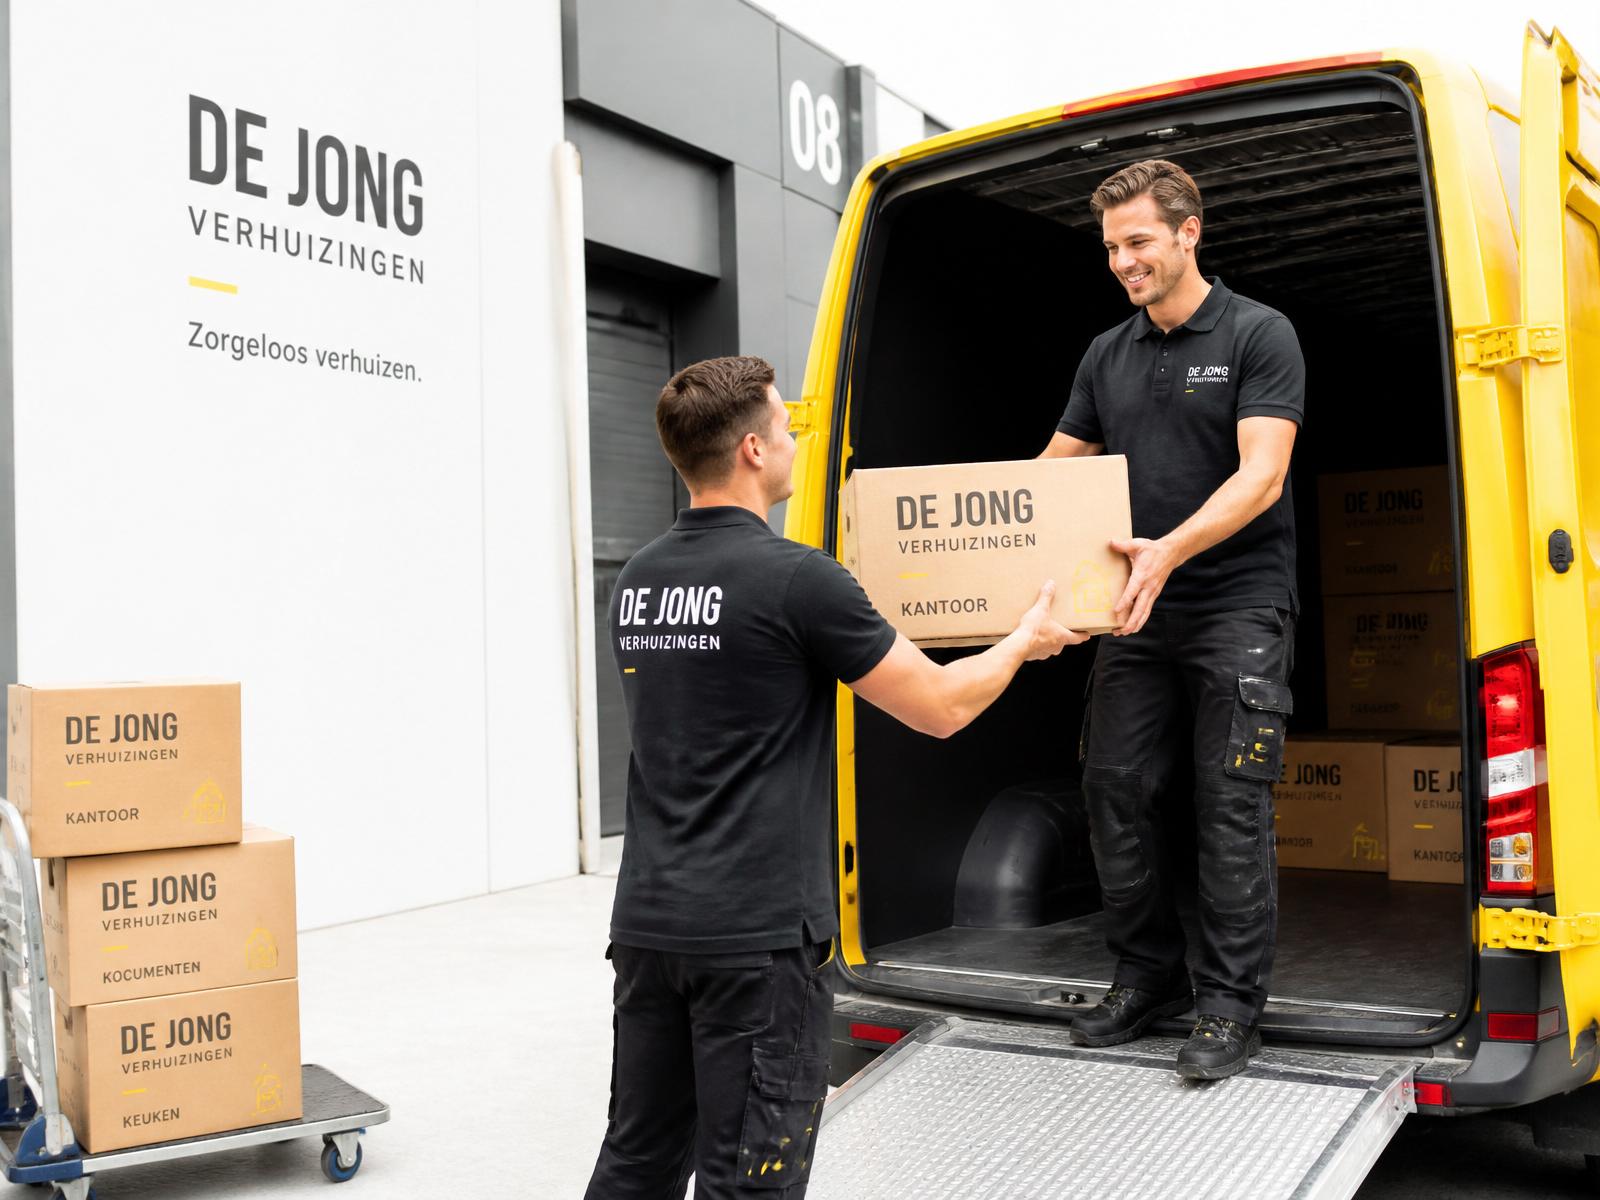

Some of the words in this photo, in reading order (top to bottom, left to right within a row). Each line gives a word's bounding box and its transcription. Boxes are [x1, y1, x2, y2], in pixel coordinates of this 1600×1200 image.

[789, 79, 842, 185] 08
[189, 93, 268, 199] DE
[288, 127, 424, 237] JONG
[188, 205, 424, 284] VERHUIZINGEN
[188, 321, 308, 364] Zorgeloos
[316, 348, 422, 383] verhuizen.
[1188, 366, 1201, 376] DE
[896, 494, 939, 531] DE
[950, 488, 1034, 528] JONG
[1376, 489, 1423, 512] JONG
[898, 533, 1036, 554] VERHUIZINGEN
[619, 587, 651, 627] DE
[653, 585, 723, 626] JONG
[901, 598, 988, 616] KANTOOR
[619, 634, 721, 651] VERHUIZINGEN
[65, 715, 101, 745] DE
[109, 712, 178, 743] JONG
[65, 749, 178, 765] VERHUIZINGEN
[1294, 764, 1341, 786] JONG
[1414, 769, 1440, 793] DE
[66, 807, 139, 825] KANTOOR
[102, 879, 138, 911] DE
[147, 871, 217, 907] JONG
[102, 908, 218, 932] VERHUIZINGEN
[102, 961, 201, 984] KOCUMENTEN
[120, 1021, 157, 1055] DE
[165, 1011, 232, 1049] JONG
[121, 1047, 233, 1075] VERHUIZINGEN
[122, 1107, 180, 1128] KEUKEN
